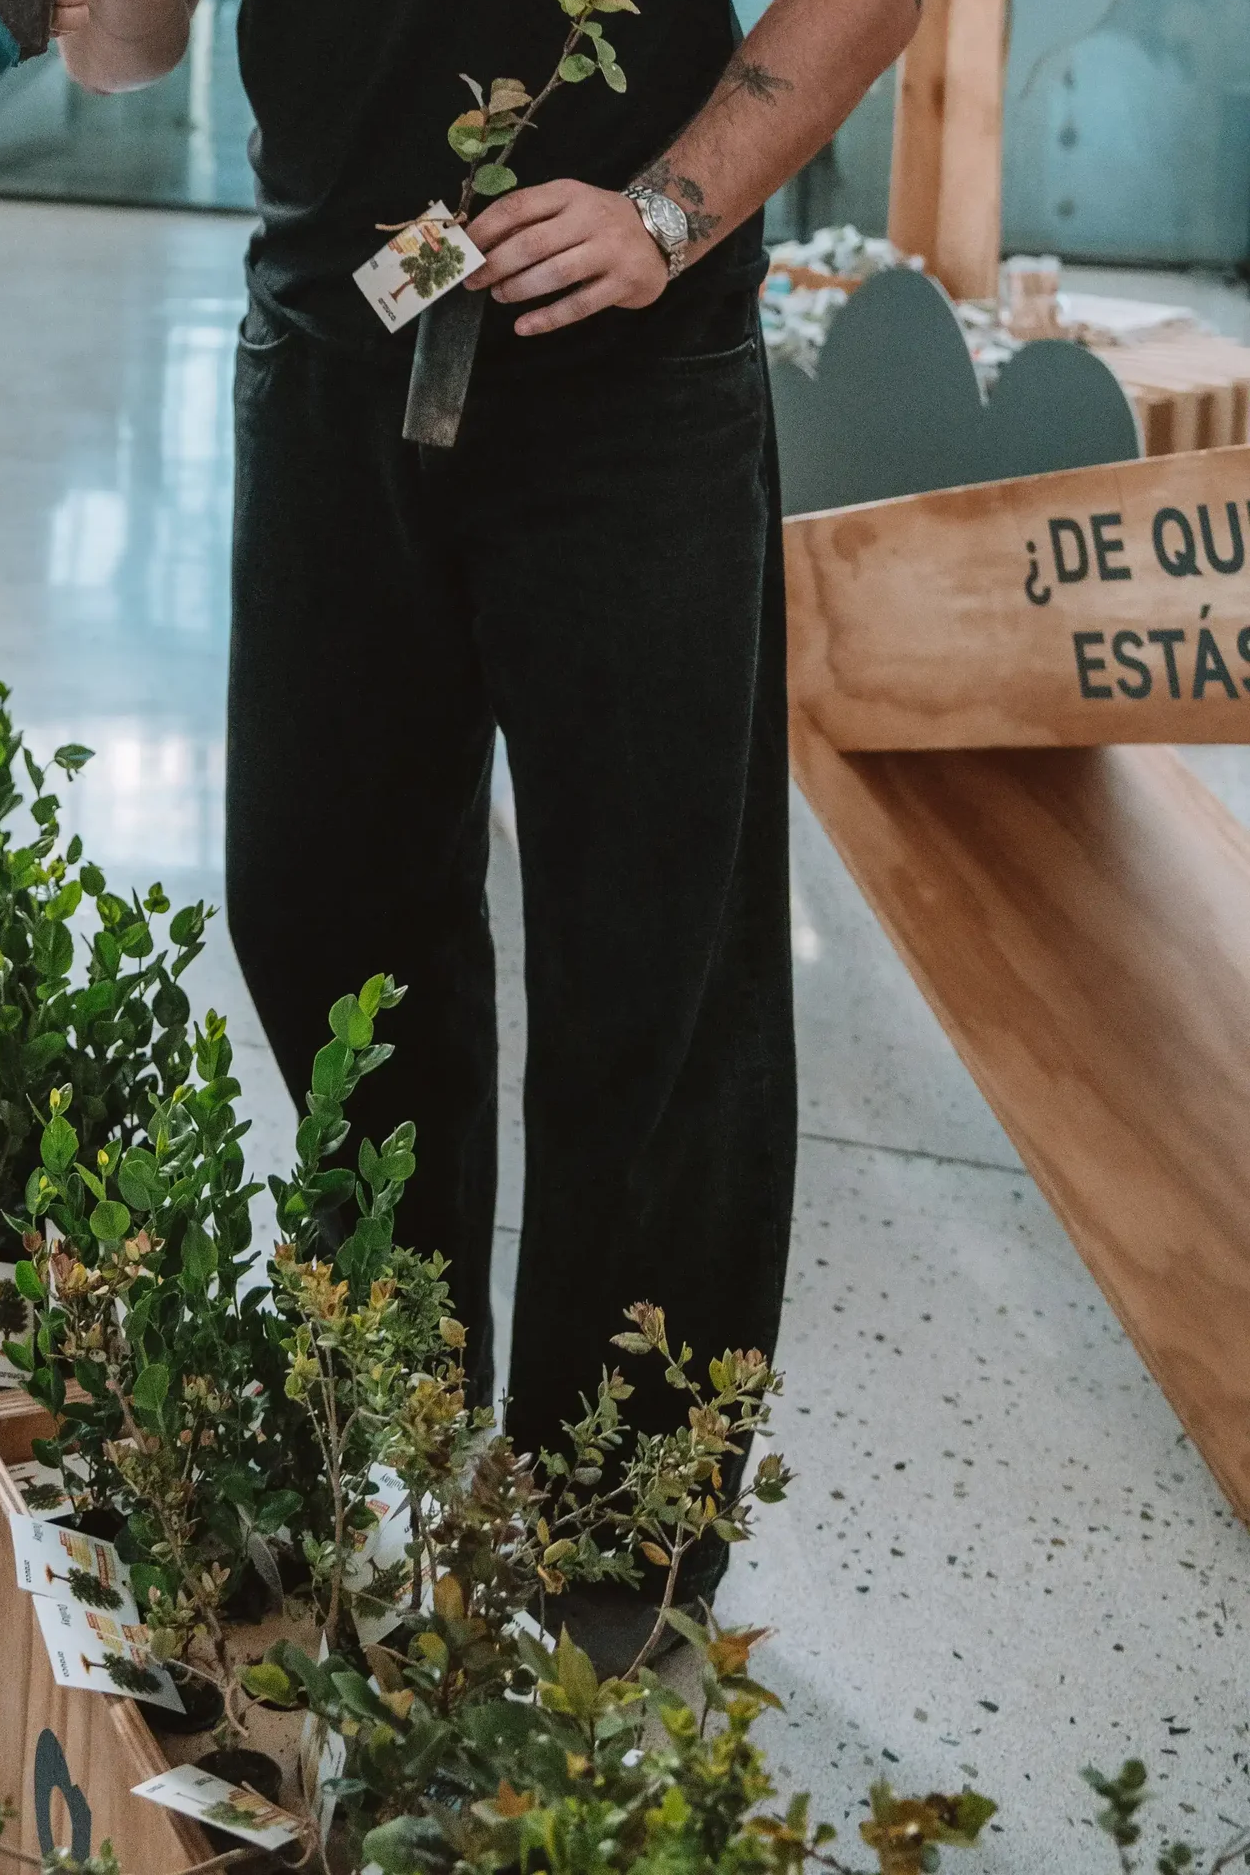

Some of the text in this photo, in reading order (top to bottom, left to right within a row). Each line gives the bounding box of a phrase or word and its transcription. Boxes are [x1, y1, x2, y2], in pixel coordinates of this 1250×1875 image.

[1025, 499, 1250, 606] ¿DE QU
[57, 1650, 70, 1678] arauco
